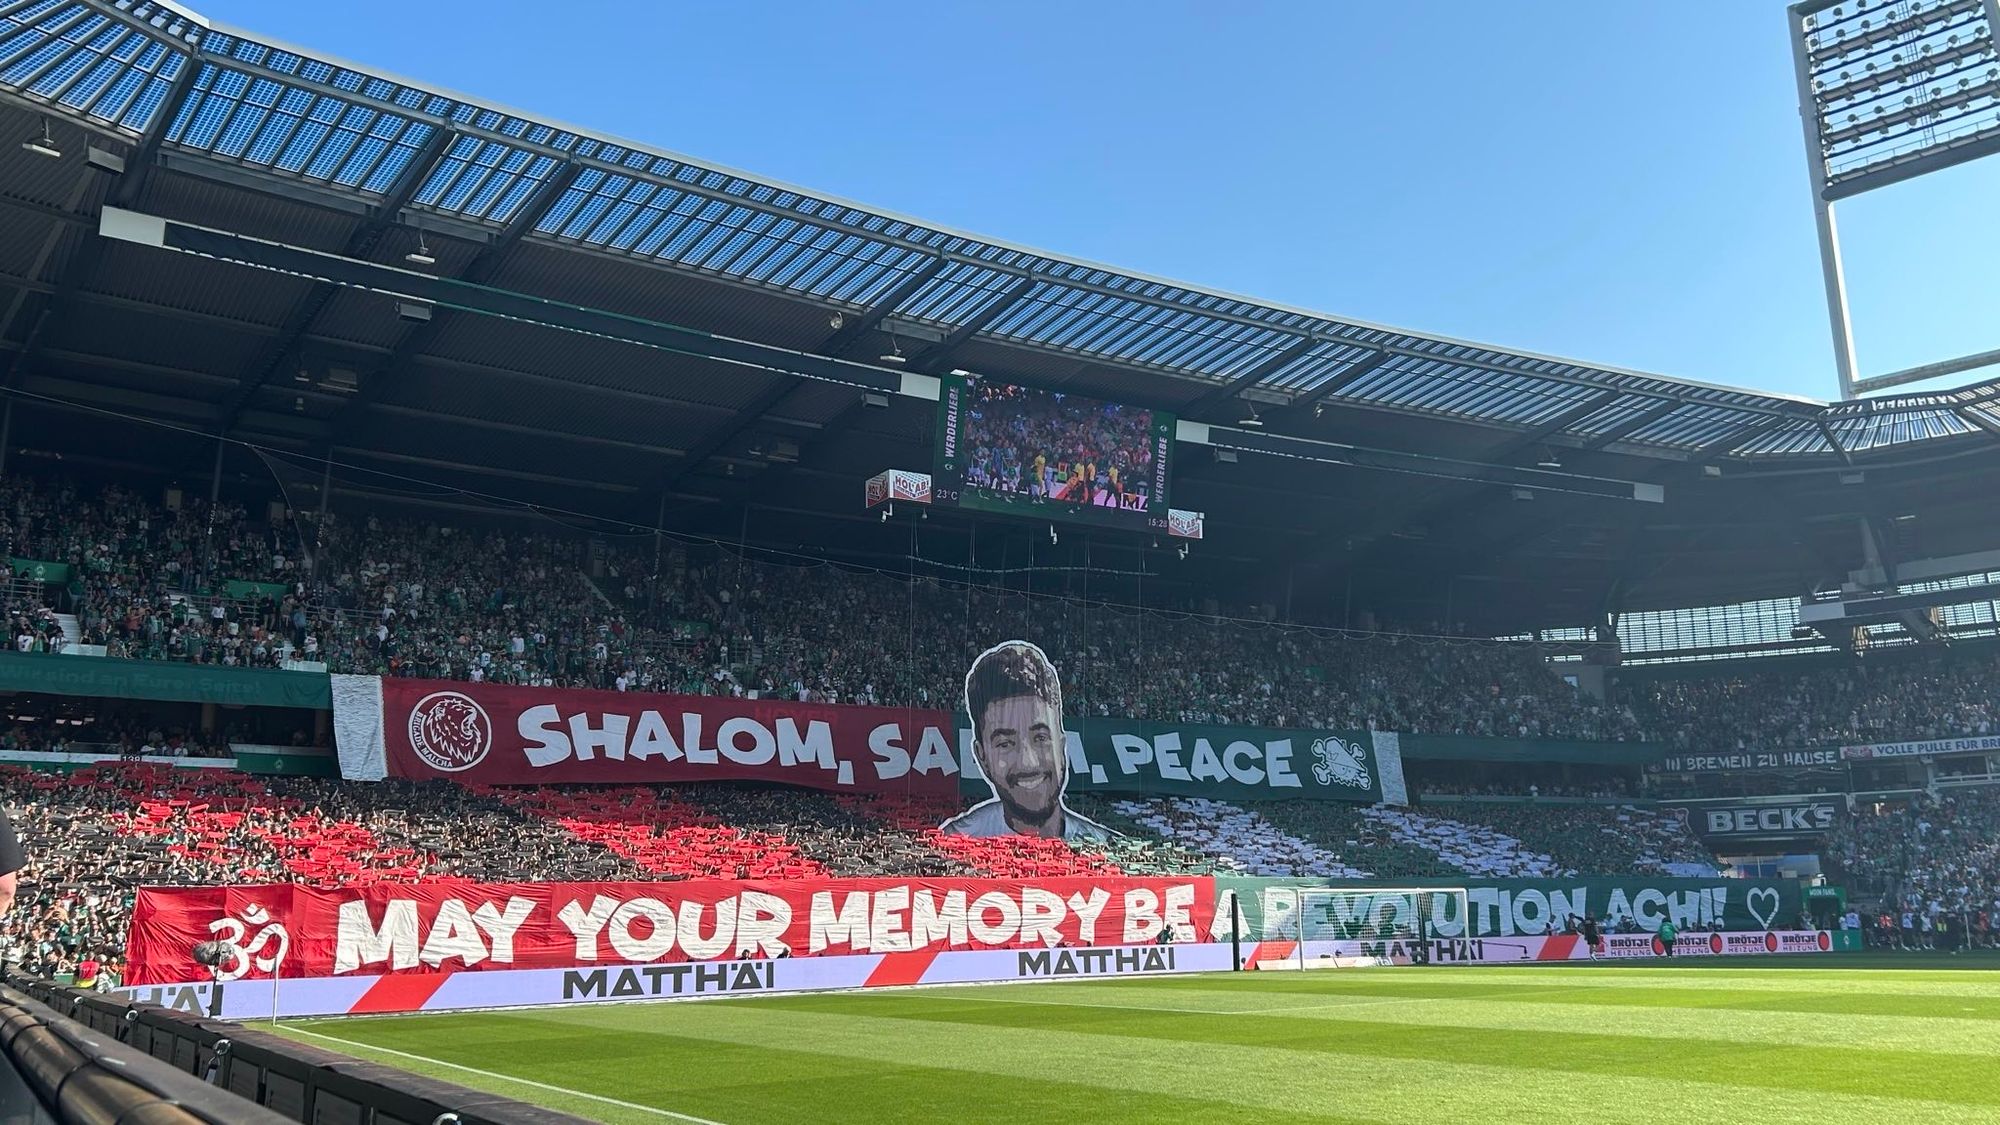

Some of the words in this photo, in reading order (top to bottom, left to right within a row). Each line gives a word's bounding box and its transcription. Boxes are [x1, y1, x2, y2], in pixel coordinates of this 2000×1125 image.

[944, 385, 960, 459] WERDERLIEBE
[1154, 437, 1168, 503] WERDERLIEBE
[412, 711, 424, 748] BRIGADE
[421, 747, 453, 767] MALCHA
[517, 704, 854, 785] SHALOM,
[1111, 732, 1303, 787] PEACE
[1876, 745, 1914, 755] VOLLE
[1917, 741, 1952, 753] PULLE
[1666, 758, 1680, 771] IN
[1687, 754, 1751, 770] BREMEN
[1757, 753, 1778, 767] ZU
[1784, 750, 1837, 766] HAUSE
[1707, 803, 1835, 833] BECK'S
[334, 896, 537, 975] MAY
[557, 891, 793, 962] YOUR
[809, 885, 1111, 955] MEMORY
[1123, 884, 1197, 944] BE
[1210, 889, 1252, 942] A
[1604, 887, 1727, 932] ACHI!
[1610, 936, 1650, 947] BRÖTJE
[1727, 935, 1764, 945] BRÖTJE
[1782, 933, 1817, 943] BRÖTJE
[1611, 948, 1651, 956] HEIZUNG
[1728, 945, 1766, 953] HEIZUNG
[1783, 943, 1818, 951] HEIZUNG
[1019, 947, 1175, 977] MATTHÄI
[563, 962, 774, 999] MATTHÄI
